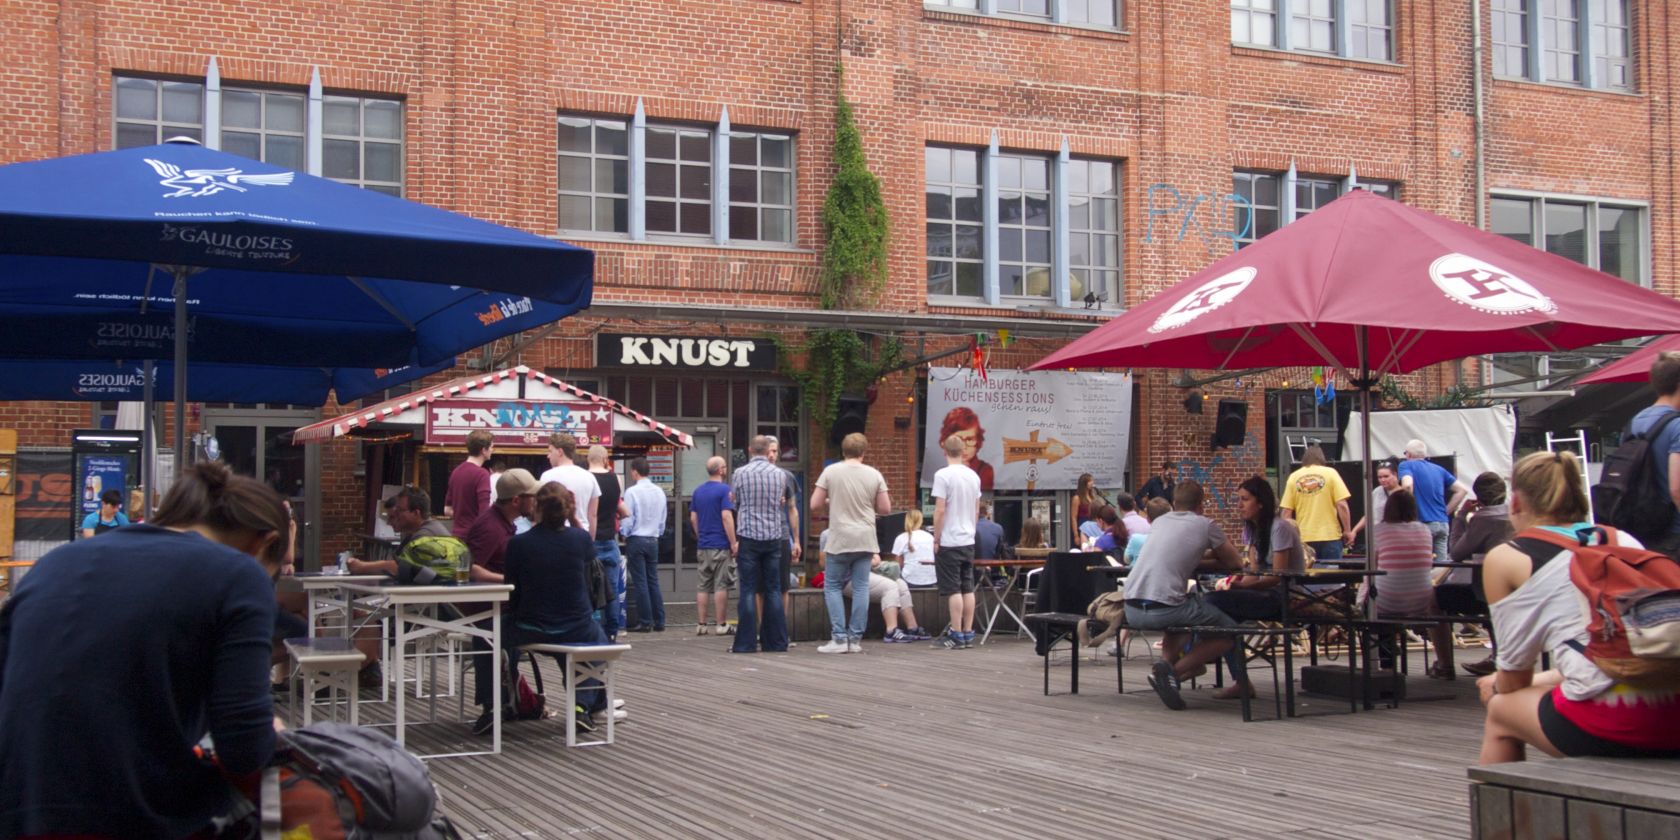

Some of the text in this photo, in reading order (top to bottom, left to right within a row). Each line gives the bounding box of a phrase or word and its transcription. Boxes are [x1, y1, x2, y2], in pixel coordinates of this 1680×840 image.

[179, 228, 293, 250] GAULOISES
[620, 337, 755, 367] KNUST
[964, 375, 1036, 391] HAMBURGER
[944, 387, 1055, 405] KÜCHENSESSIONS
[991, 401, 1023, 413] gehen
[432, 408, 591, 429] KNUST
